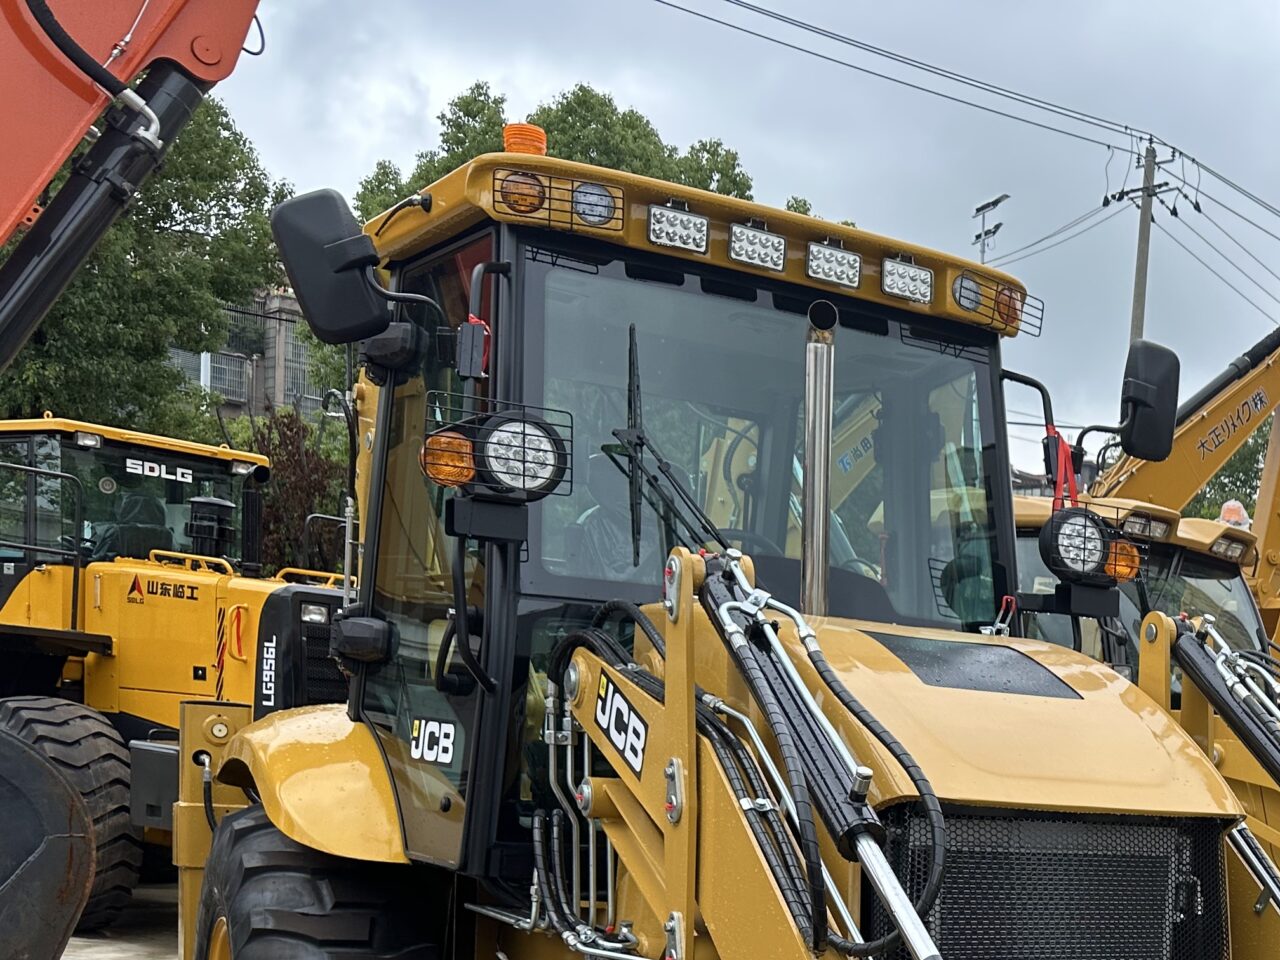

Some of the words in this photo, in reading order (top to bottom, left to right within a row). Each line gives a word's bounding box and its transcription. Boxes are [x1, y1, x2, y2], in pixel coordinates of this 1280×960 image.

[126, 458, 193, 483] SDLG
[147, 580, 199, 601] 山东临工
[262, 635, 276, 706] LG956L
[410, 719, 456, 764] JCB
[596, 681, 647, 773] JCB
